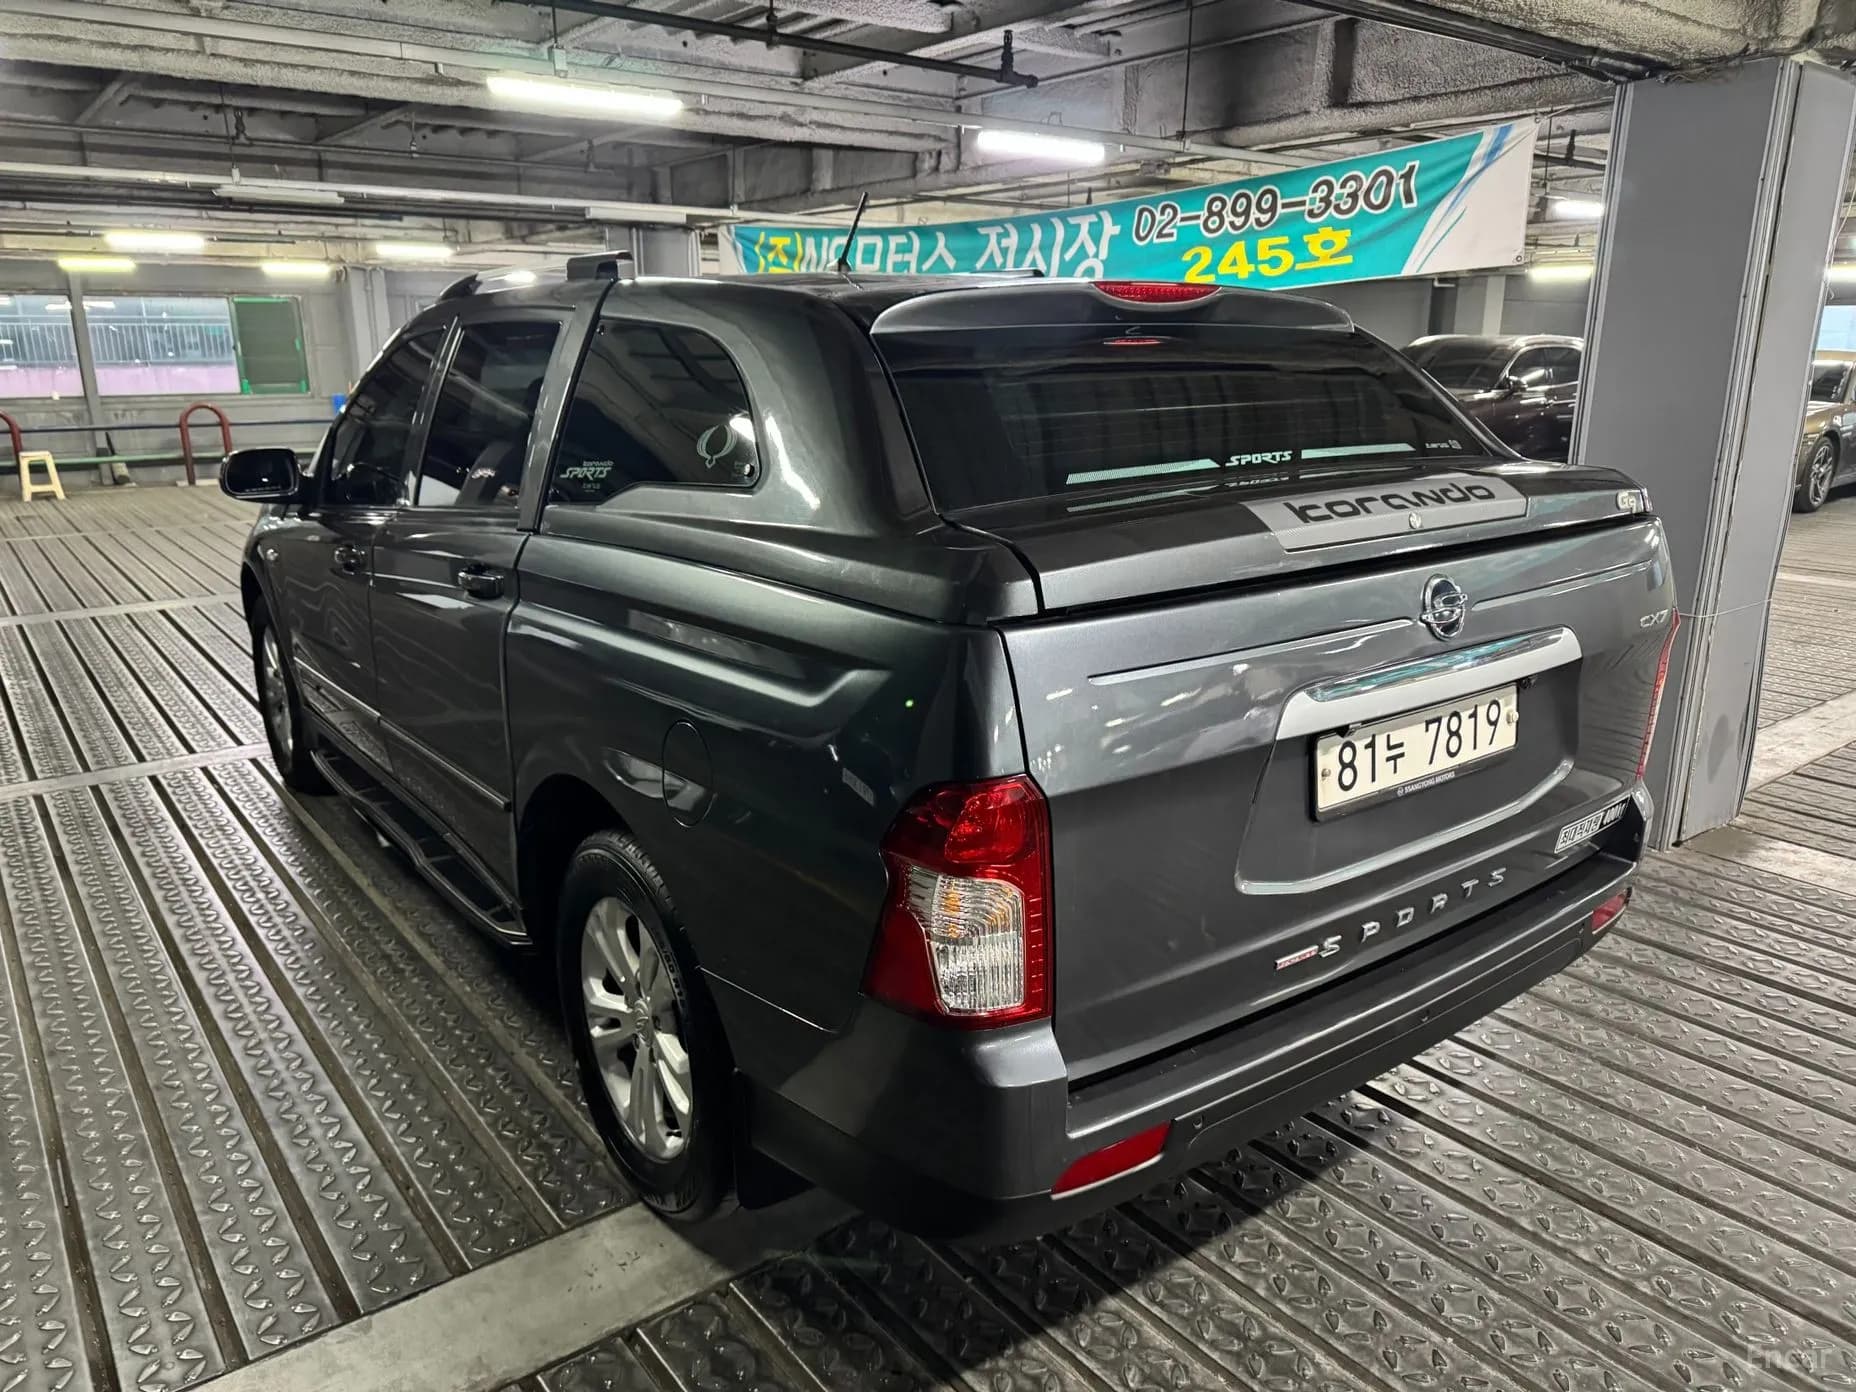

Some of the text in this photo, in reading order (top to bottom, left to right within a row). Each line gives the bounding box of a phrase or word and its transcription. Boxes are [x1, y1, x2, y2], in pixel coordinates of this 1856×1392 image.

[1133, 161, 1418, 244] 02-899-3301
[1181, 227, 1353, 283] 245호
[560, 467, 612, 480] SPORTS
[1225, 451, 1292, 467] SPORTS
[1640, 609, 1668, 628] CX7
[1337, 699, 1502, 792] 81누 7819
[1319, 867, 1507, 958] SPORTS
